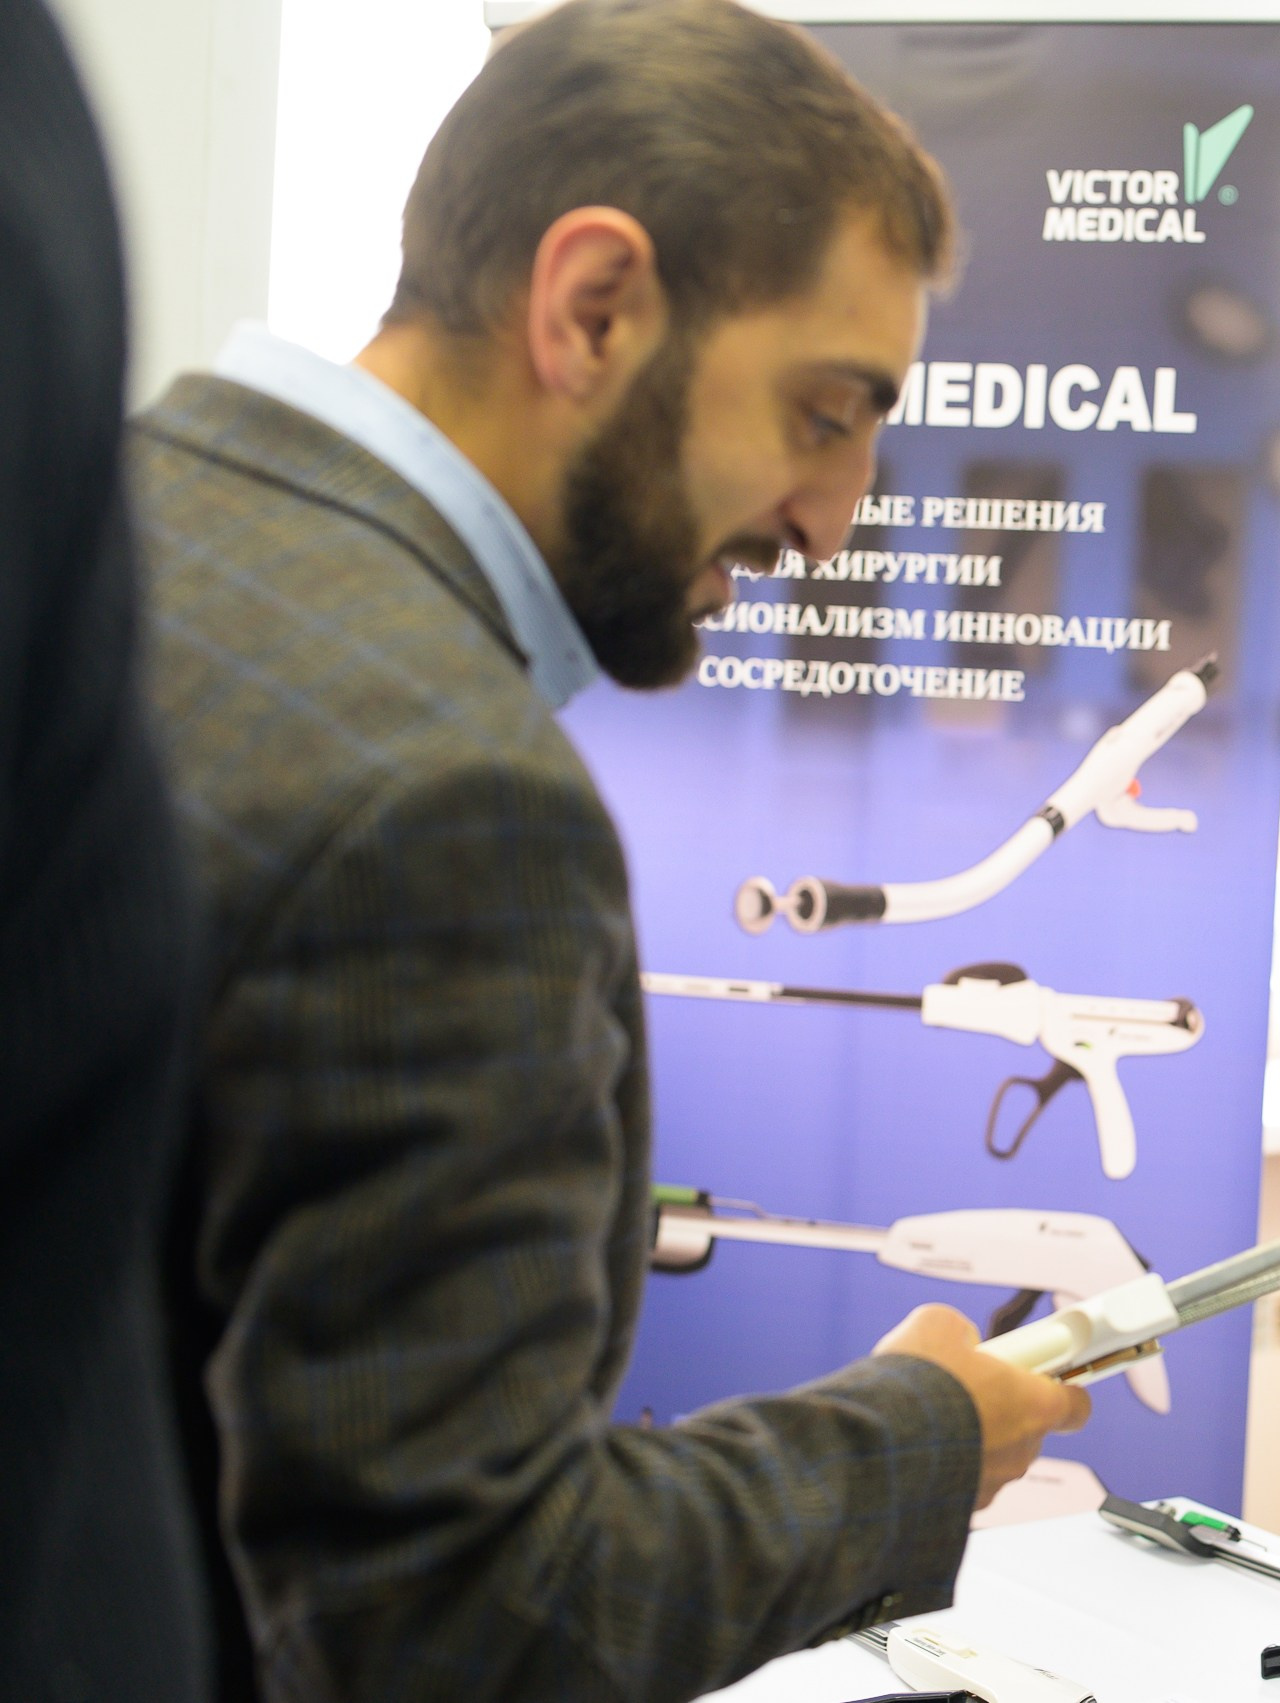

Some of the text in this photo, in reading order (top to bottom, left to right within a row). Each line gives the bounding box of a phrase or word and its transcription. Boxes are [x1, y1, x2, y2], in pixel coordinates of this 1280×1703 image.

[1046, 169, 1179, 205] VICTOR
[1042, 207, 1206, 243] MEDICAL
[920, 496, 1108, 533] РЕШЕНИЯ
[811, 550, 1003, 586] ХИРУРГИИ
[932, 609, 1172, 654] ИННОВАЦИИ
[697, 655, 1026, 702] СОСРЕДОТОЧЕНИЕ
